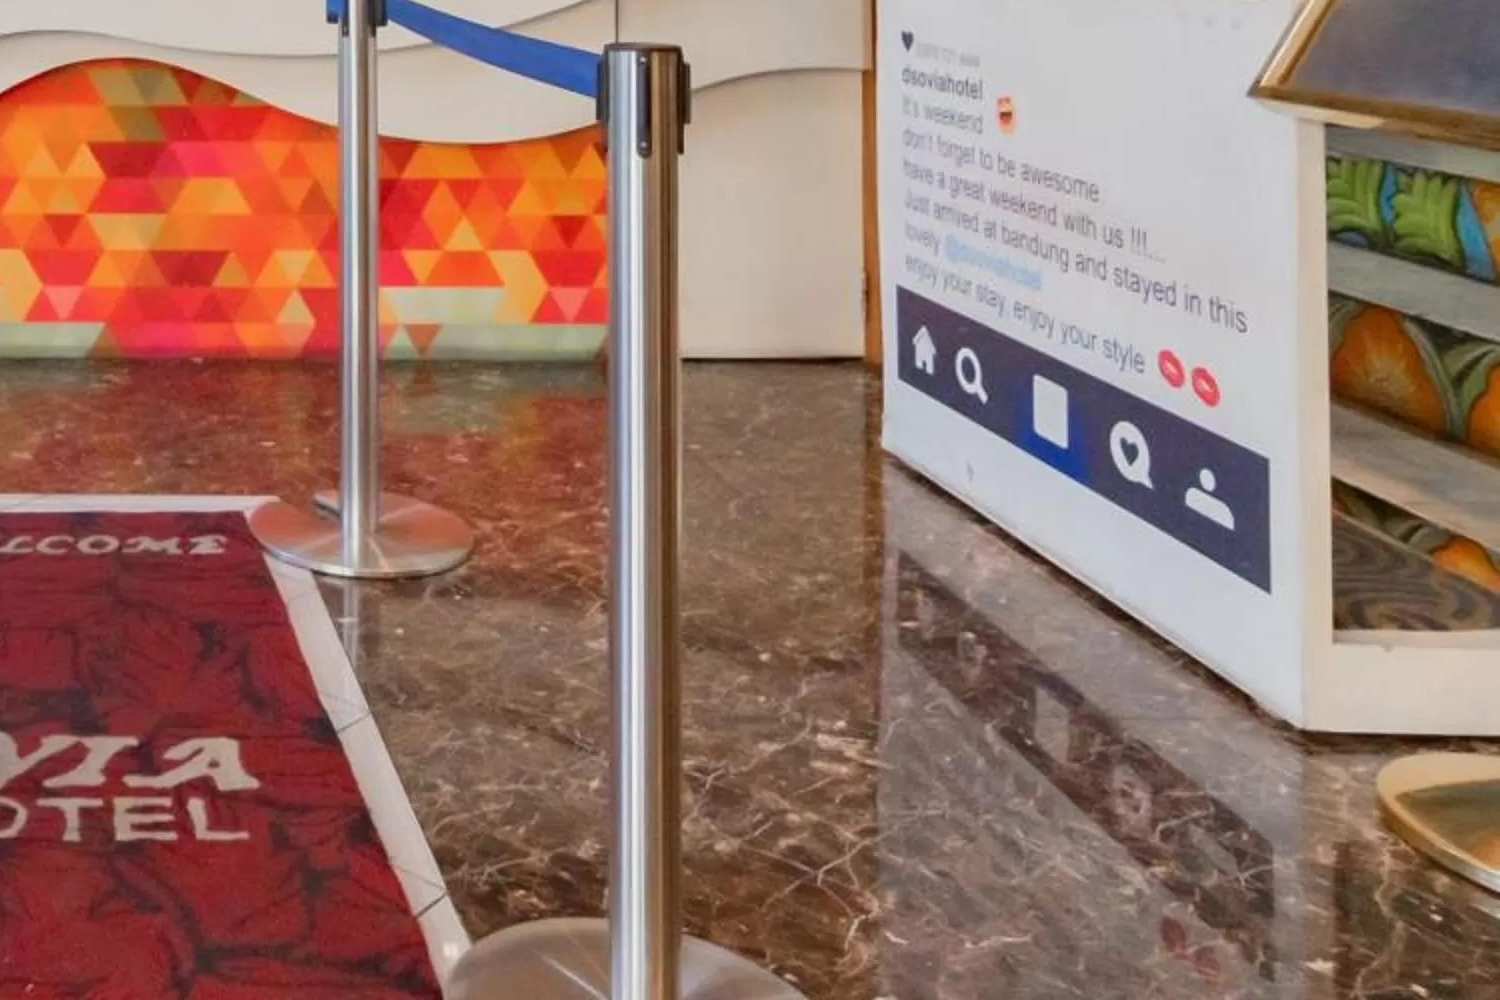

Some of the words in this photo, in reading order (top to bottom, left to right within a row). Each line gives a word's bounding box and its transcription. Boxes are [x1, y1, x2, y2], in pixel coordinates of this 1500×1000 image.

[902, 67, 983, 100] dsoviahotel
[979, 147, 993, 170] to
[997, 152, 1016, 178] be
[936, 171, 945, 189] a
[950, 174, 986, 201] great
[989, 185, 1057, 226] weekend
[1062, 213, 1097, 241] with
[1102, 224, 1124, 249] us
[983, 219, 997, 240] at
[1001, 220, 1070, 273] bandung
[1075, 250, 1108, 281] and
[1113, 265, 1177, 307] stayed
[1183, 283, 1203, 316] in
[1208, 295, 1249, 334] this
[1013, 299, 1055, 341] enjoy
[1060, 319, 1098, 350] your
[1103, 335, 1146, 374] style
